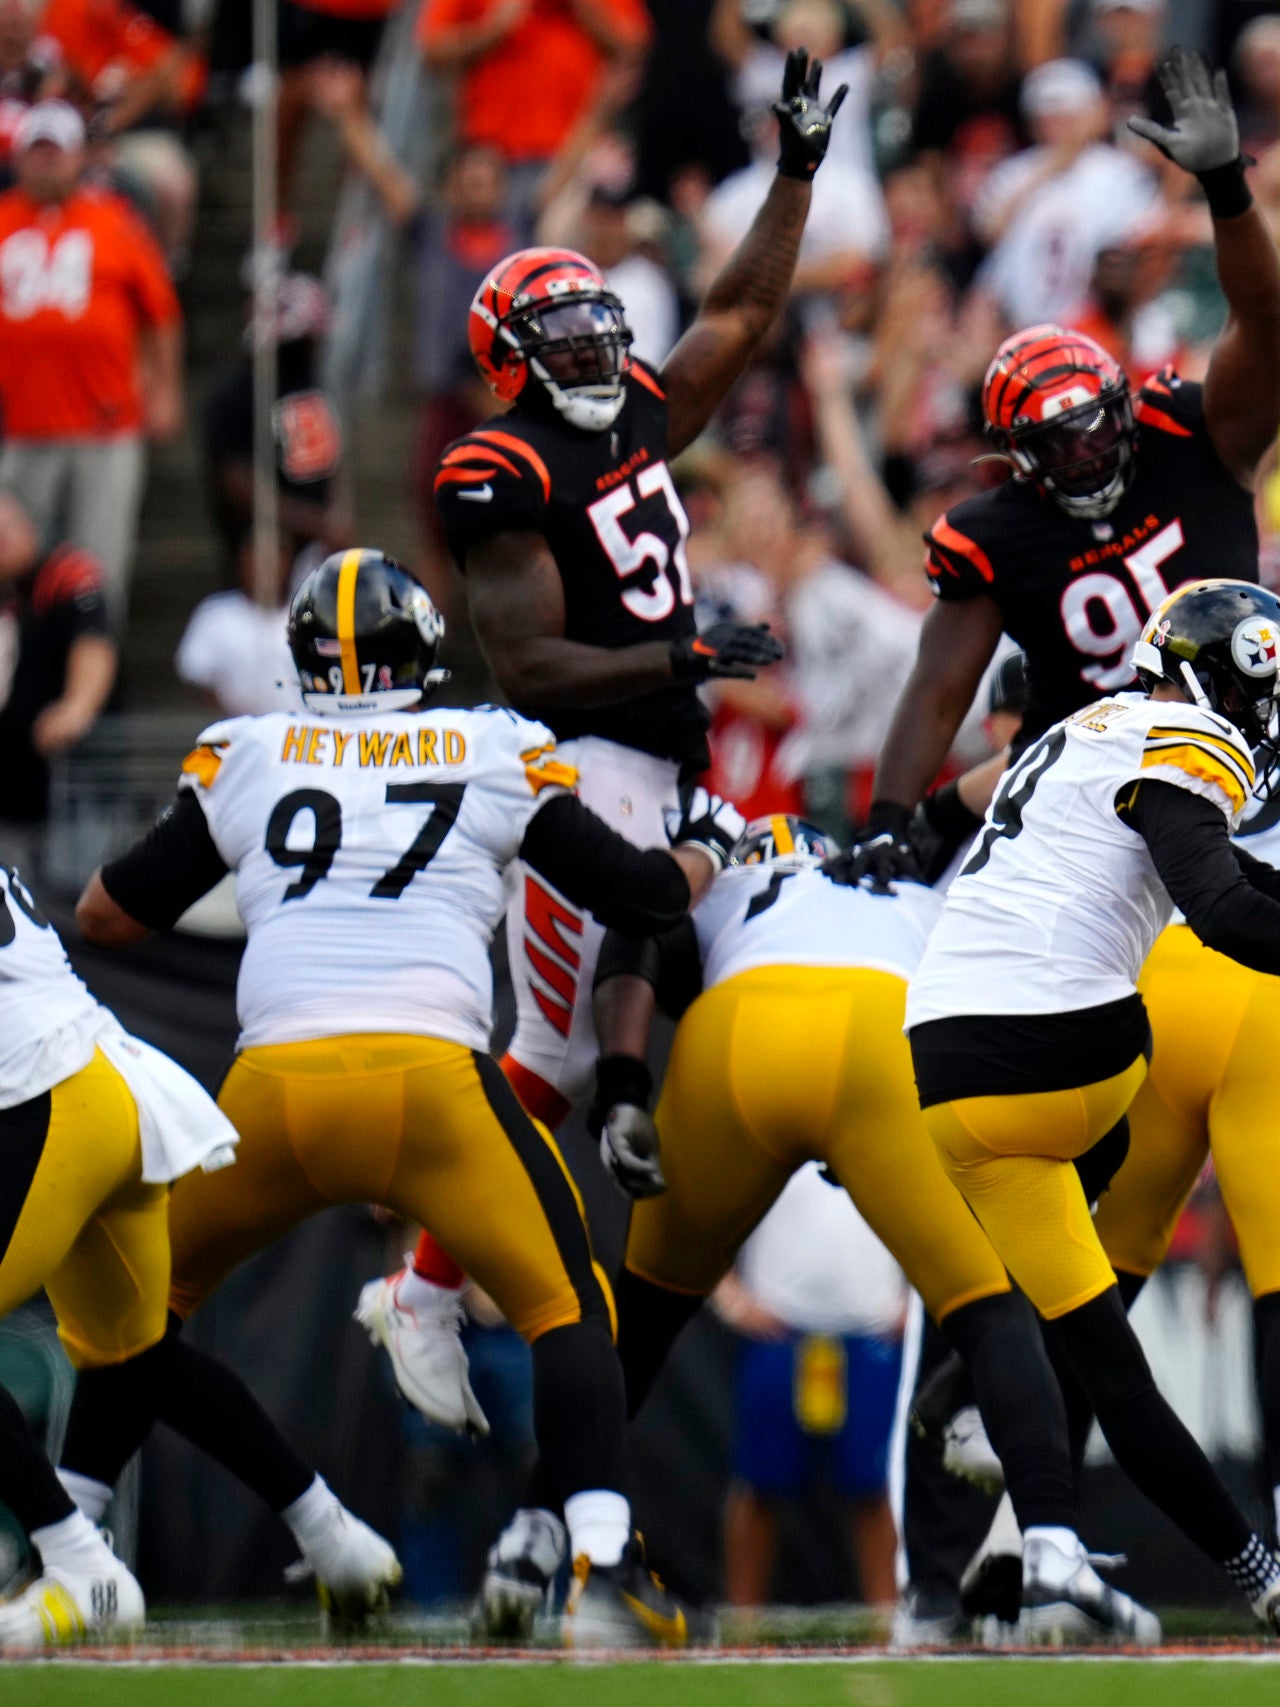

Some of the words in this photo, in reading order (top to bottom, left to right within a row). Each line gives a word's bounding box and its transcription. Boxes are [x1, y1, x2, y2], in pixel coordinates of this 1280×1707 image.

[586, 459, 695, 622] 57
[1069, 514, 1160, 573] BENGALS
[328, 663, 378, 696] 97
[281, 726, 467, 768] HEYWARD
[265, 782, 469, 904] 97
[957, 727, 1067, 876] 9
